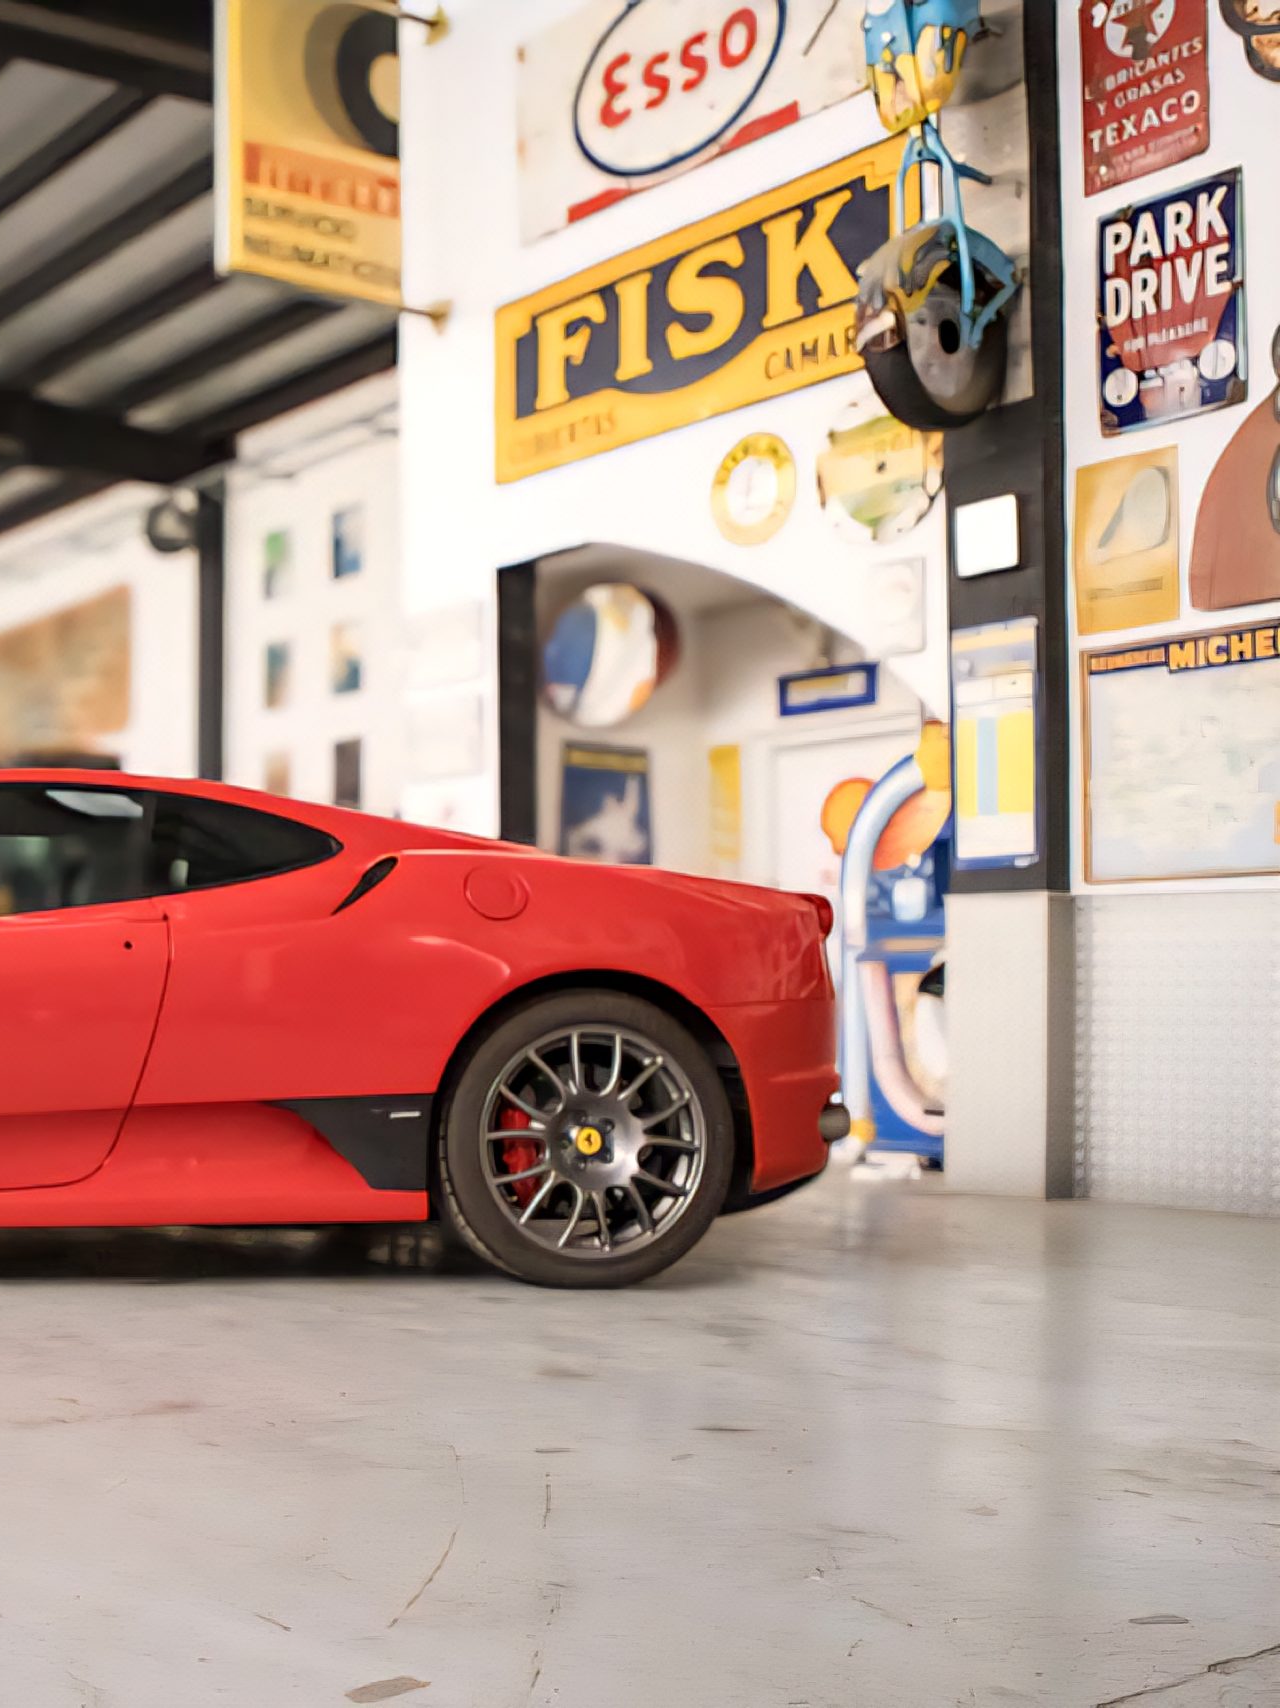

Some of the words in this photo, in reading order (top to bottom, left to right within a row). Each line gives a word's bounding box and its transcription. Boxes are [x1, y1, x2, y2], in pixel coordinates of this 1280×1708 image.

[1084, 36, 1203, 100] LBRICANTES
[1096, 102, 1108, 117] Y
[1113, 67, 1186, 109] GRASAS
[1087, 89, 1201, 153] TEXACO
[1105, 186, 1229, 275] PARK
[533, 187, 861, 411] FISK
[1105, 242, 1233, 328] DRIVE
[1169, 625, 1280, 671] MICHE
